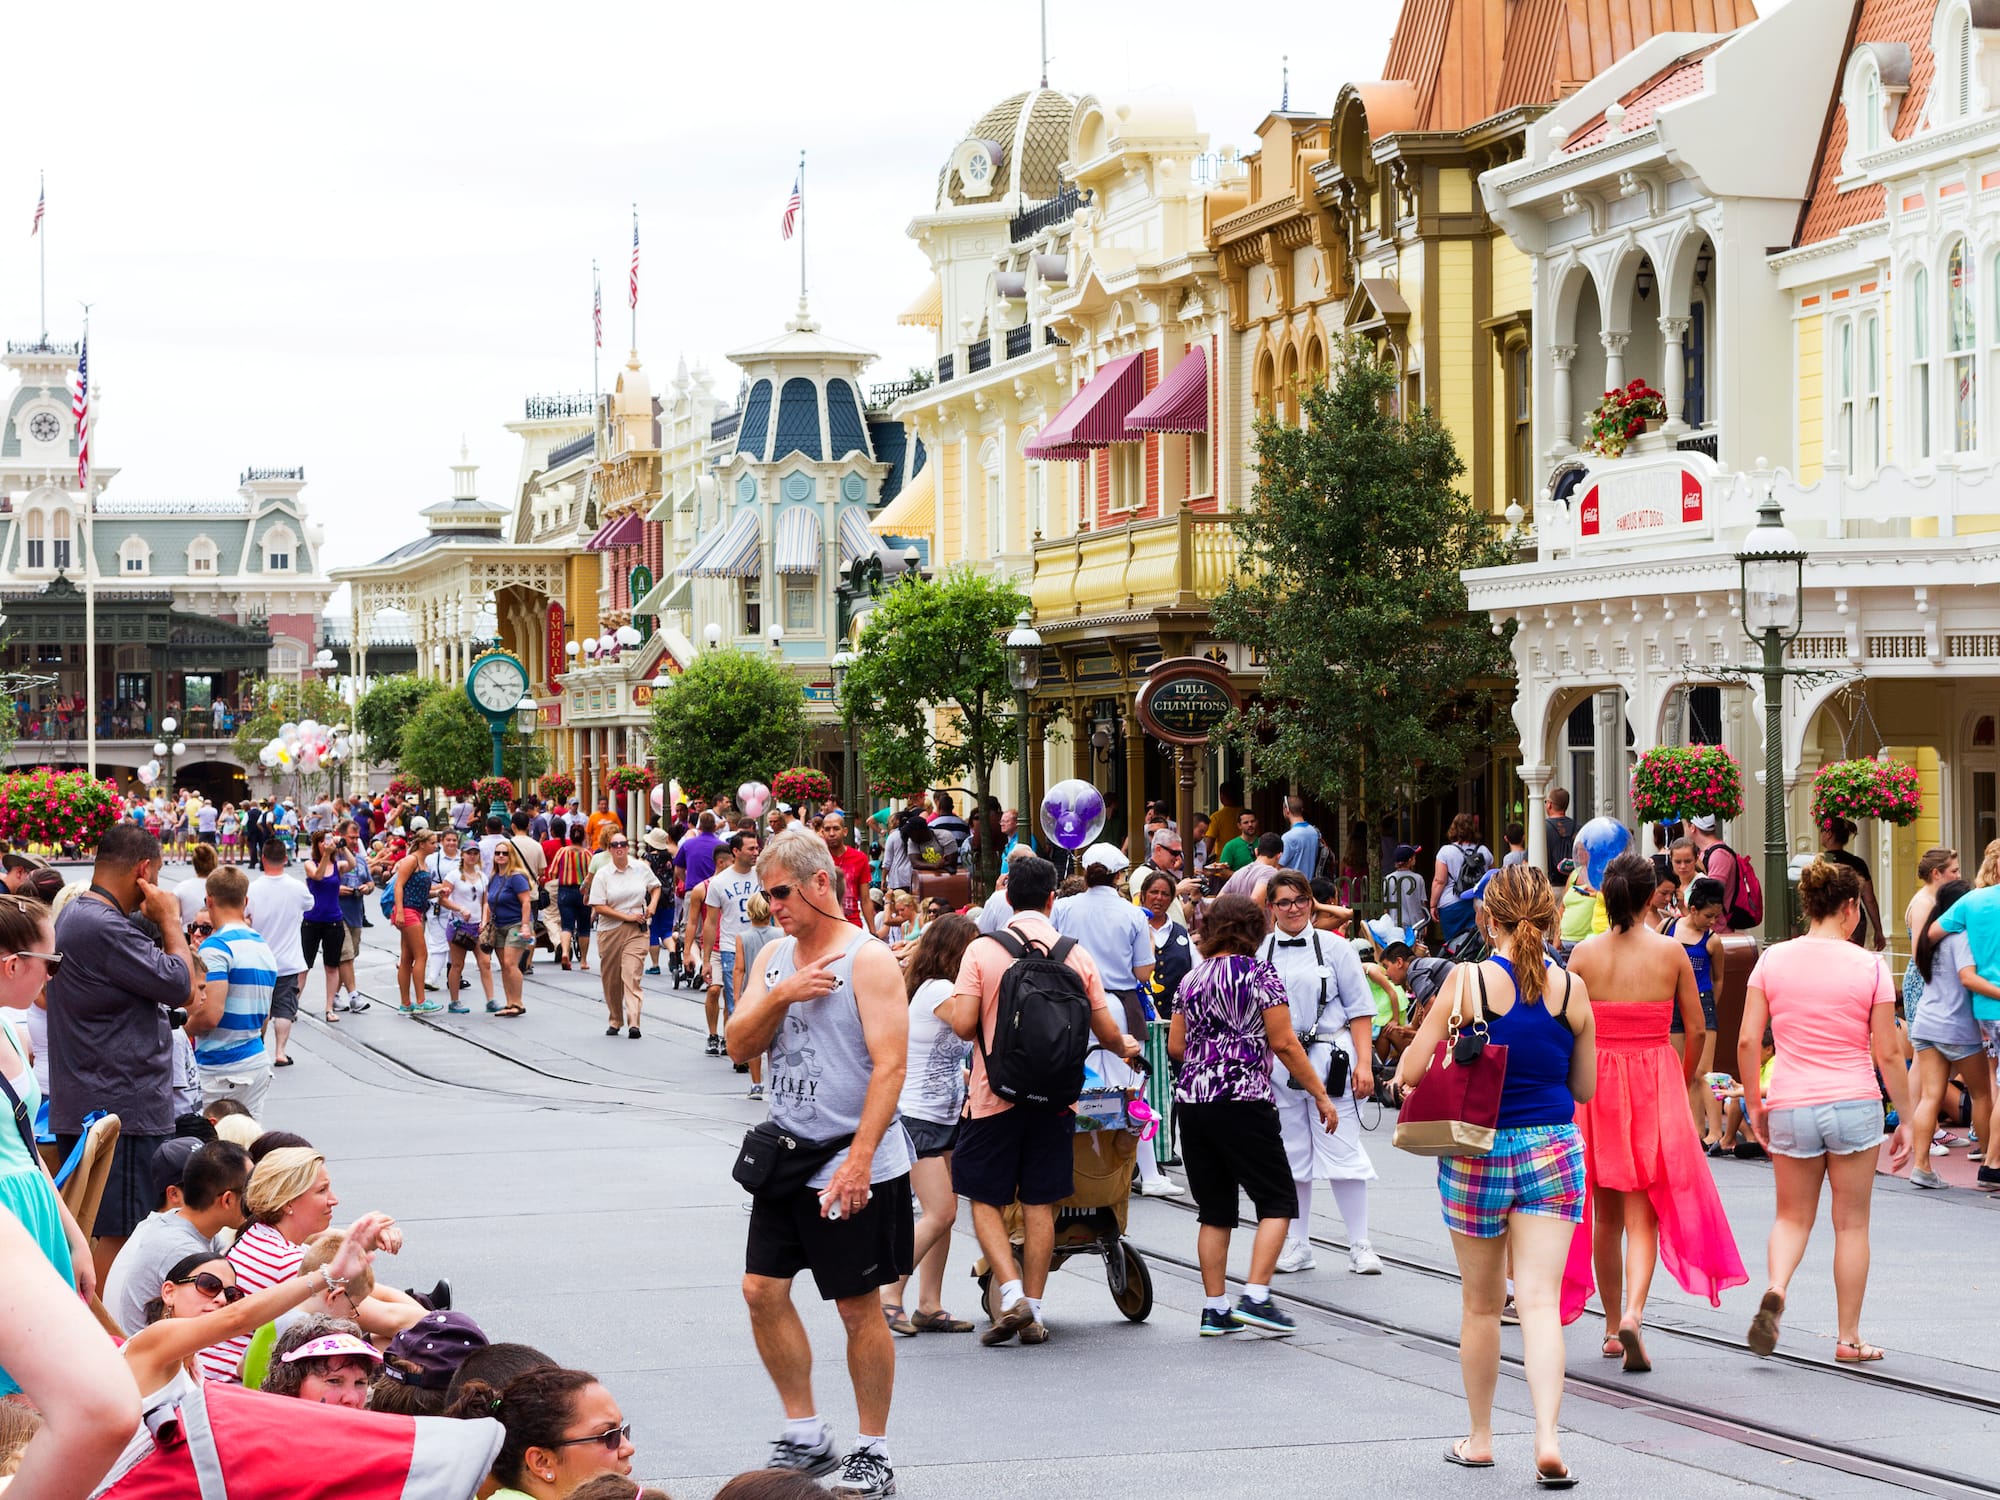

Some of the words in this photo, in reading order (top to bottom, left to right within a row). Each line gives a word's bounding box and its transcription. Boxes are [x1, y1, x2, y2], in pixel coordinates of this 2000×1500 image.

[1617, 511, 1637, 531] FAMOUS
[1638, 509, 1649, 528] HOT
[1649, 509, 1664, 526] DOGS
[1175, 684, 1208, 694] HALL
[1154, 701, 1228, 712] CHAMPIONS
